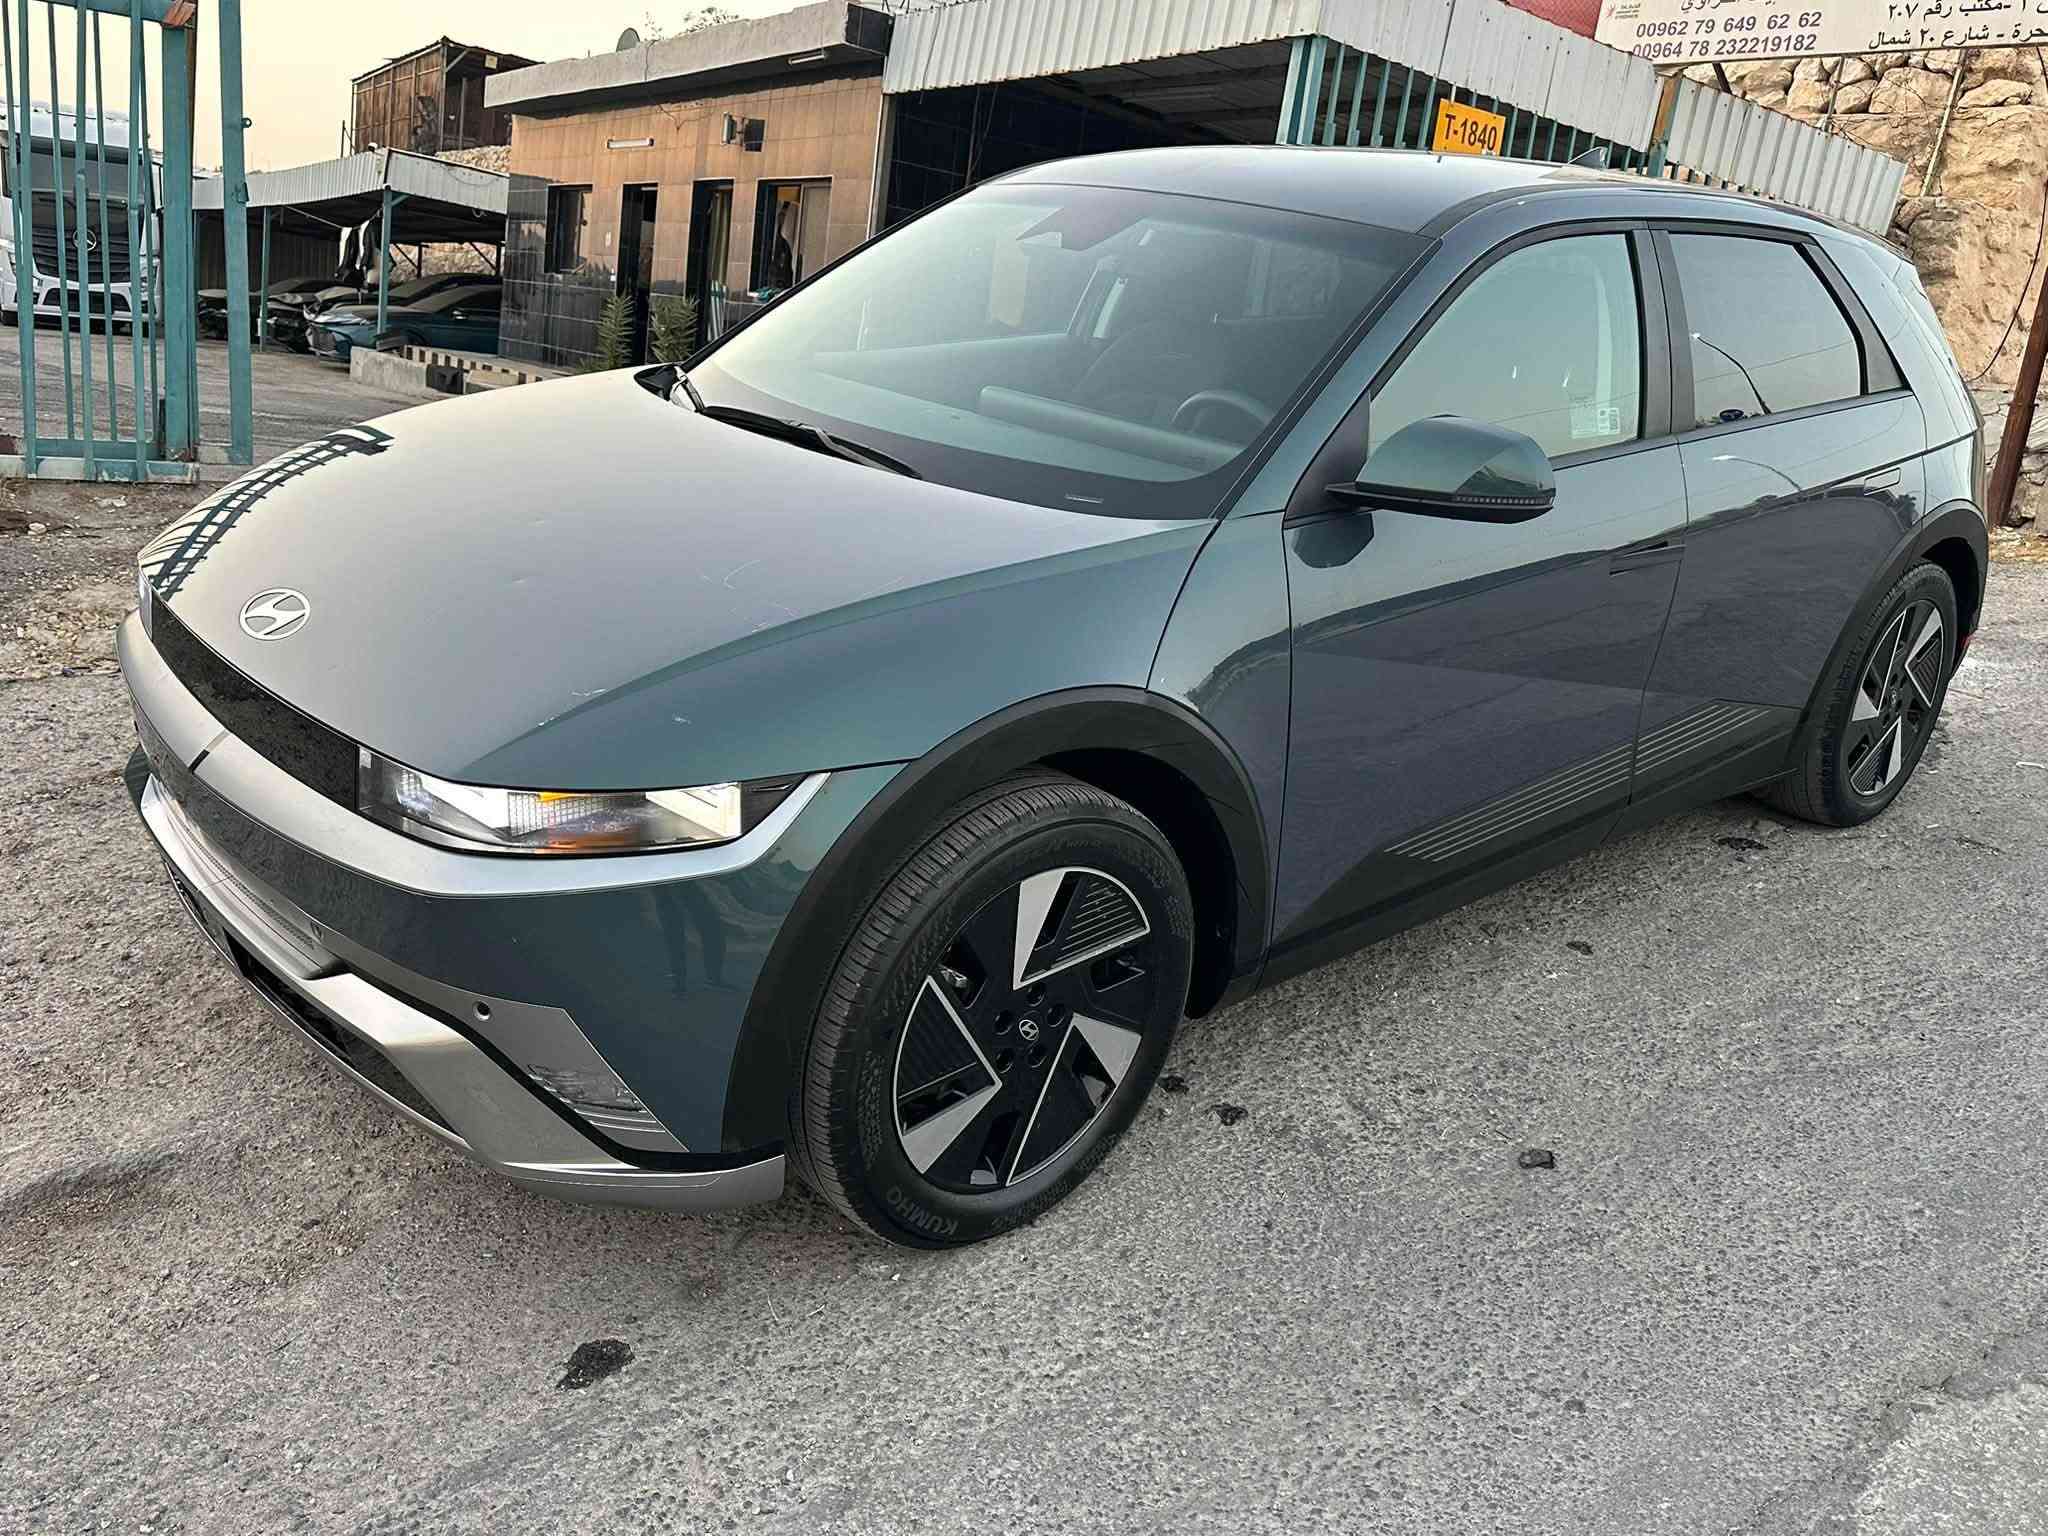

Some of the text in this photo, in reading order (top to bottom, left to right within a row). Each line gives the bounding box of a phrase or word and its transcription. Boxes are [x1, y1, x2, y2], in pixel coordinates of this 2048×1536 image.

[1889, 3, 1919, 20] ٢٠٧
[1923, 0, 1952, 21] رقم
[1636, 11, 1821, 37] 00962 79 649 62 62
[1633, 34, 1817, 58] 00964 78 232219182
[1868, 29, 1911, 49] شمال
[1920, 28, 1934, 46] ٢٠
[1941, 25, 1989, 48] شارع
[1445, 113, 1497, 151] T-1840
[886, 1186, 958, 1235] KUMHO
